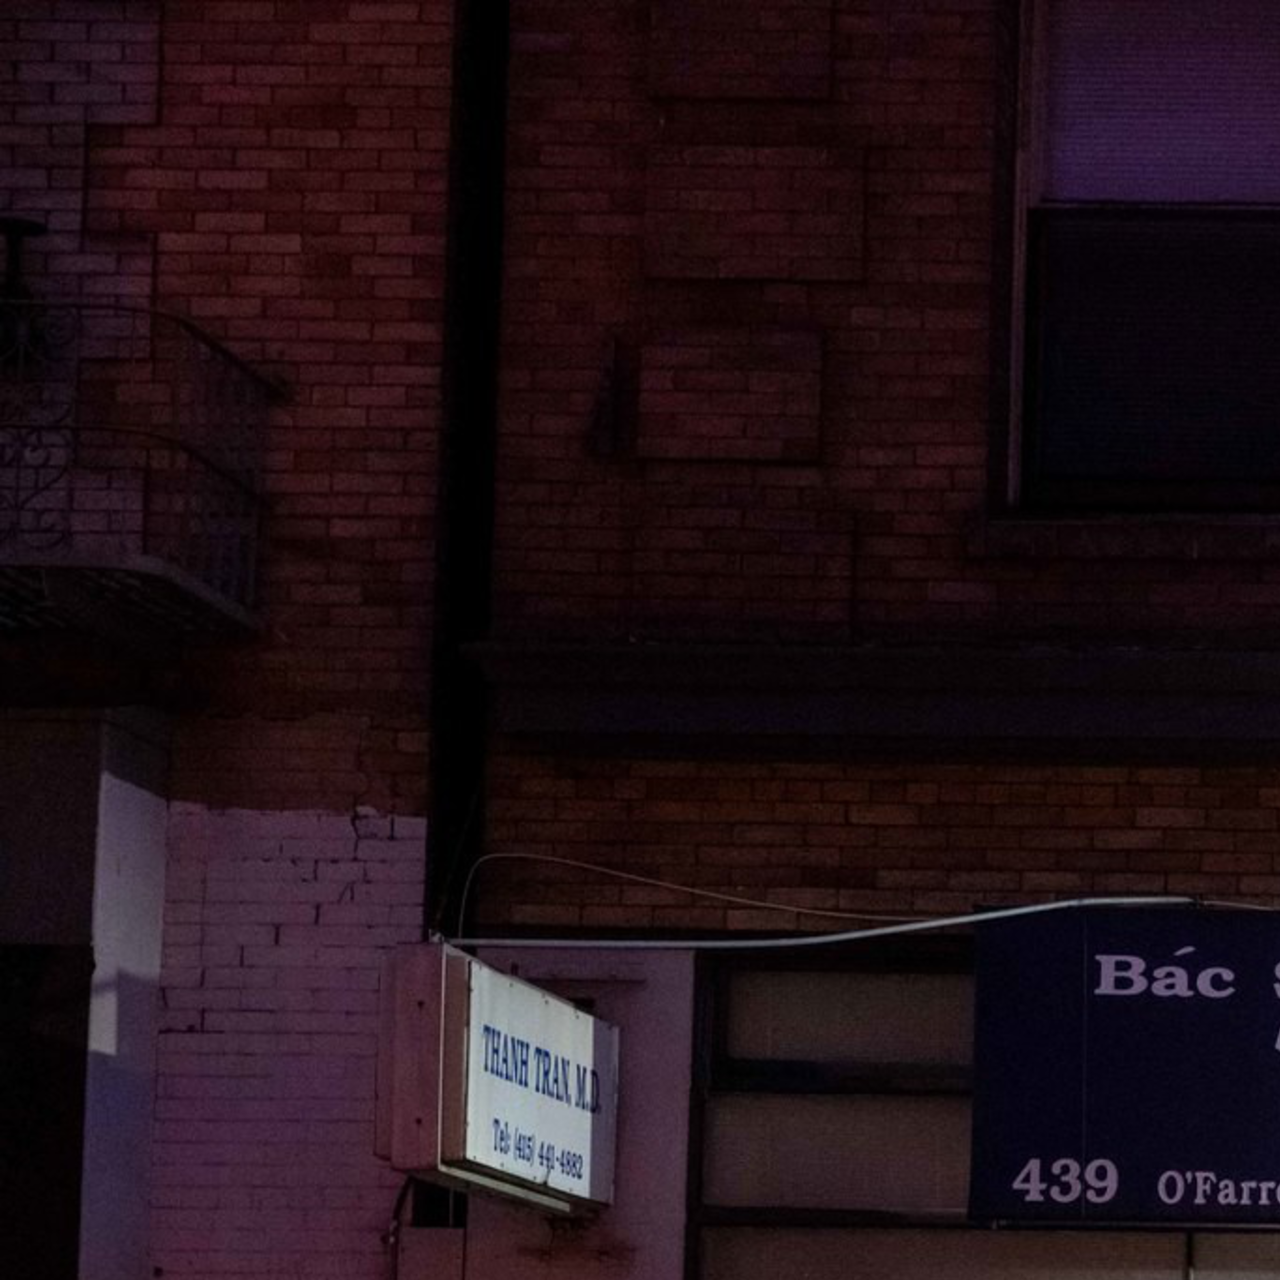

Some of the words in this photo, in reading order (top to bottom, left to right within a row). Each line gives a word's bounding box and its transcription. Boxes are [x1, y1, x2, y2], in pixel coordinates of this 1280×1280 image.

[483, 1024, 530, 1088] THANH
[575, 1063, 602, 1114] M.D.
[514, 1127, 537, 1167] (415)
[1011, 1158, 1119, 1203] 439
